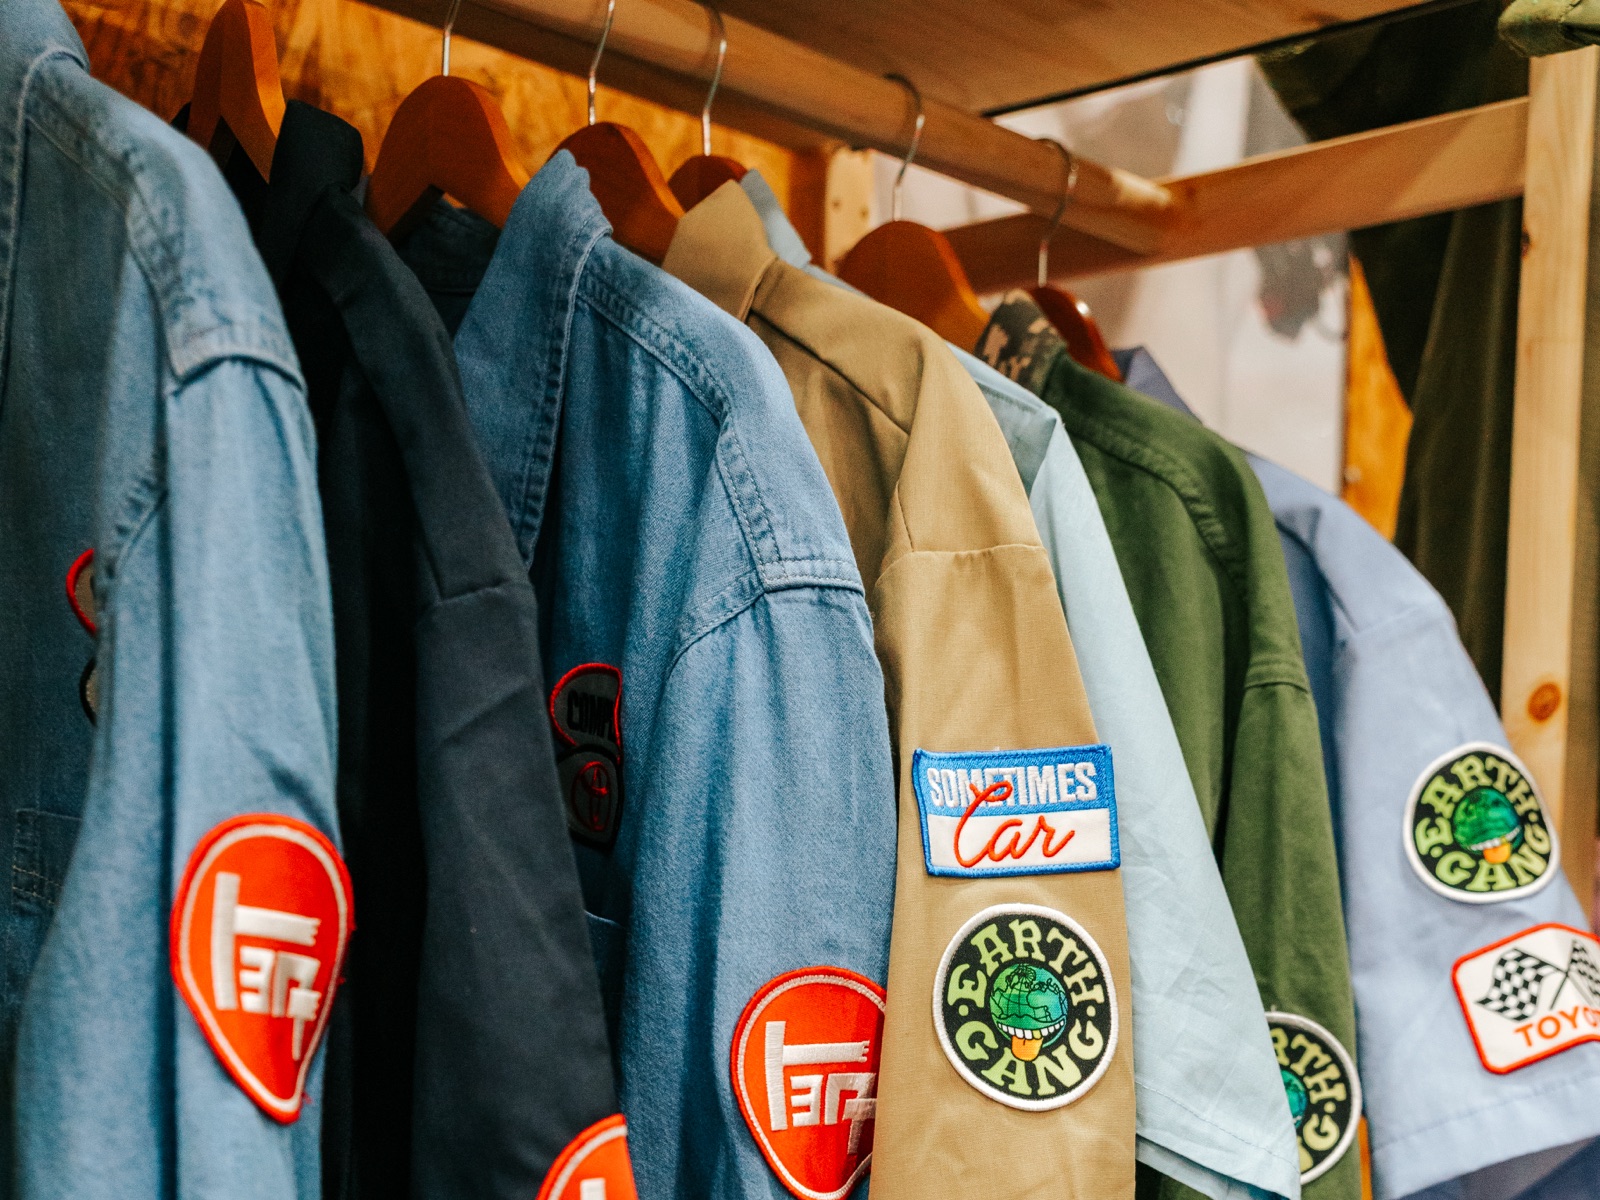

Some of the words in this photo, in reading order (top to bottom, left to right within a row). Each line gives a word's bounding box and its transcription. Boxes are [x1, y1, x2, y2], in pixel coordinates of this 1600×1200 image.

[926, 761, 1098, 808] SOMETIMES
[953, 780, 1076, 868] Car
[1415, 755, 1540, 856] EARTH
[1435, 823, 1551, 892] GANG
[947, 918, 1105, 1009] EARTH
[955, 1018, 1104, 1096] GANG
